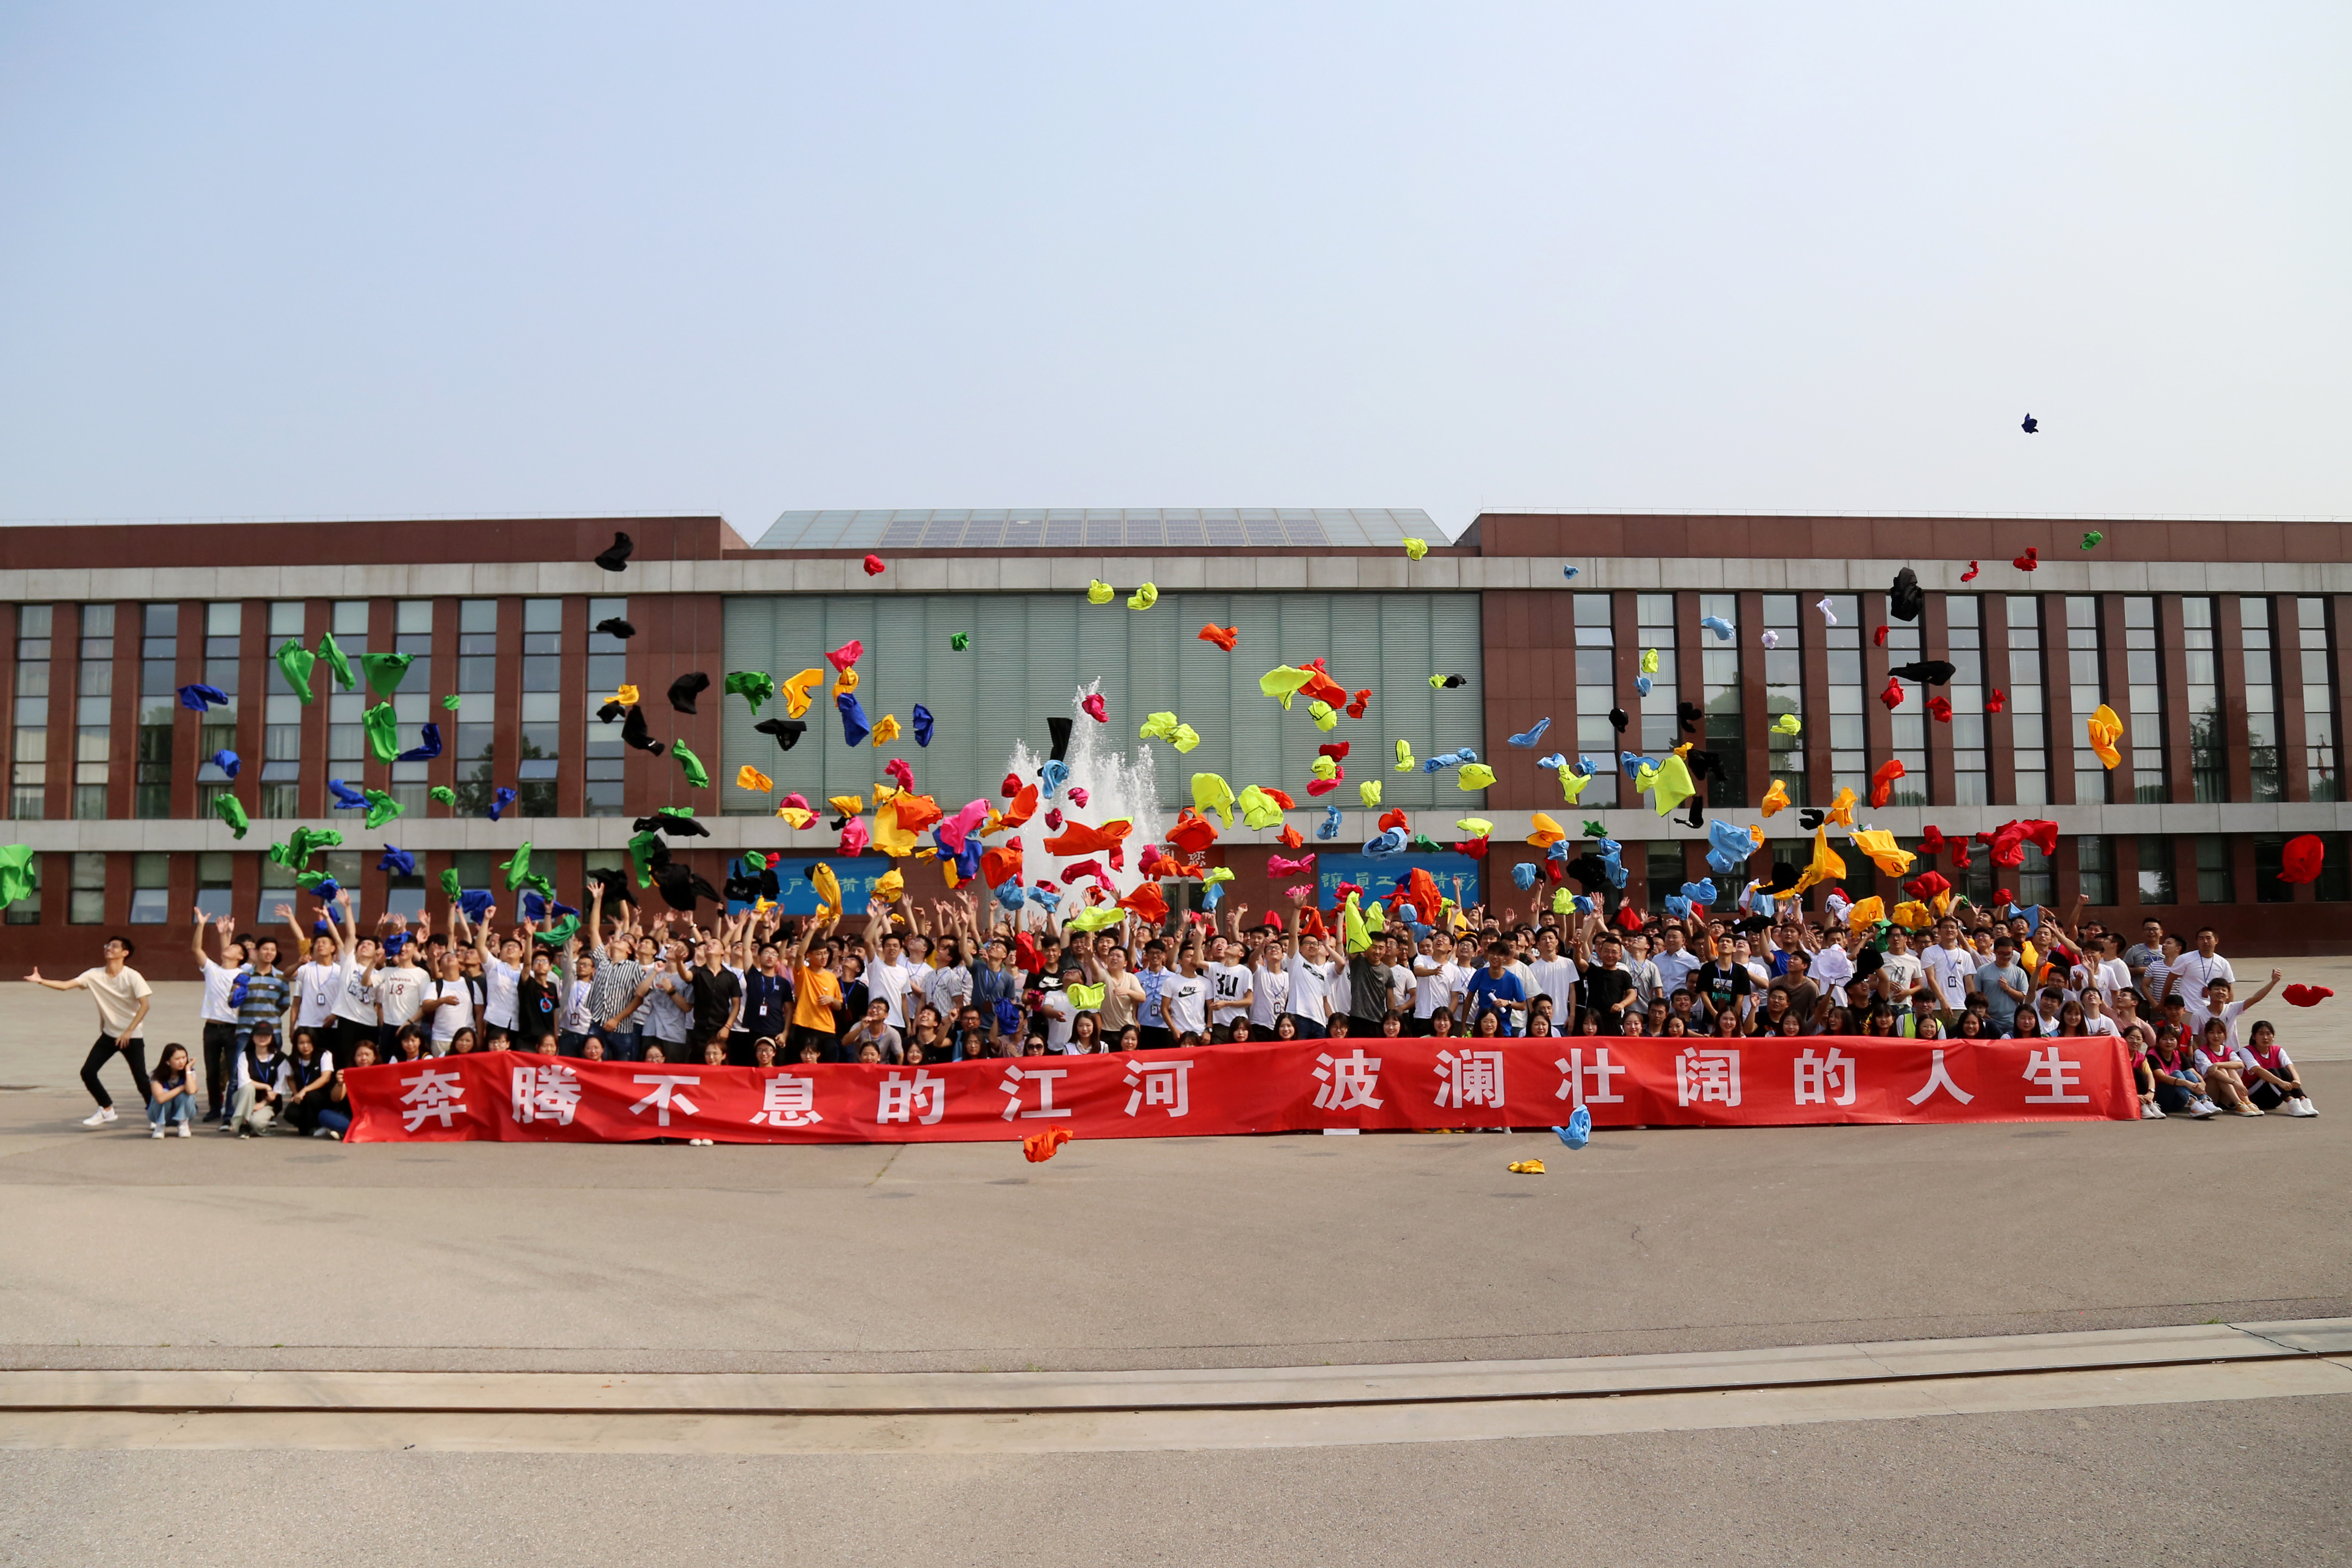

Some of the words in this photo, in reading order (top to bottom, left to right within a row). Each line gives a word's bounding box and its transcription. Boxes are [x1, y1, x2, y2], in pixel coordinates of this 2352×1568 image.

[1320, 871, 1477, 891] 讓員工精彩
[1043, 976, 1060, 984] NIKE
[389, 984, 404, 995] 18
[400, 1060, 1194, 1132] 奔腾不息的江河
[1311, 1047, 2090, 1111] 波澜壮阔的人生
